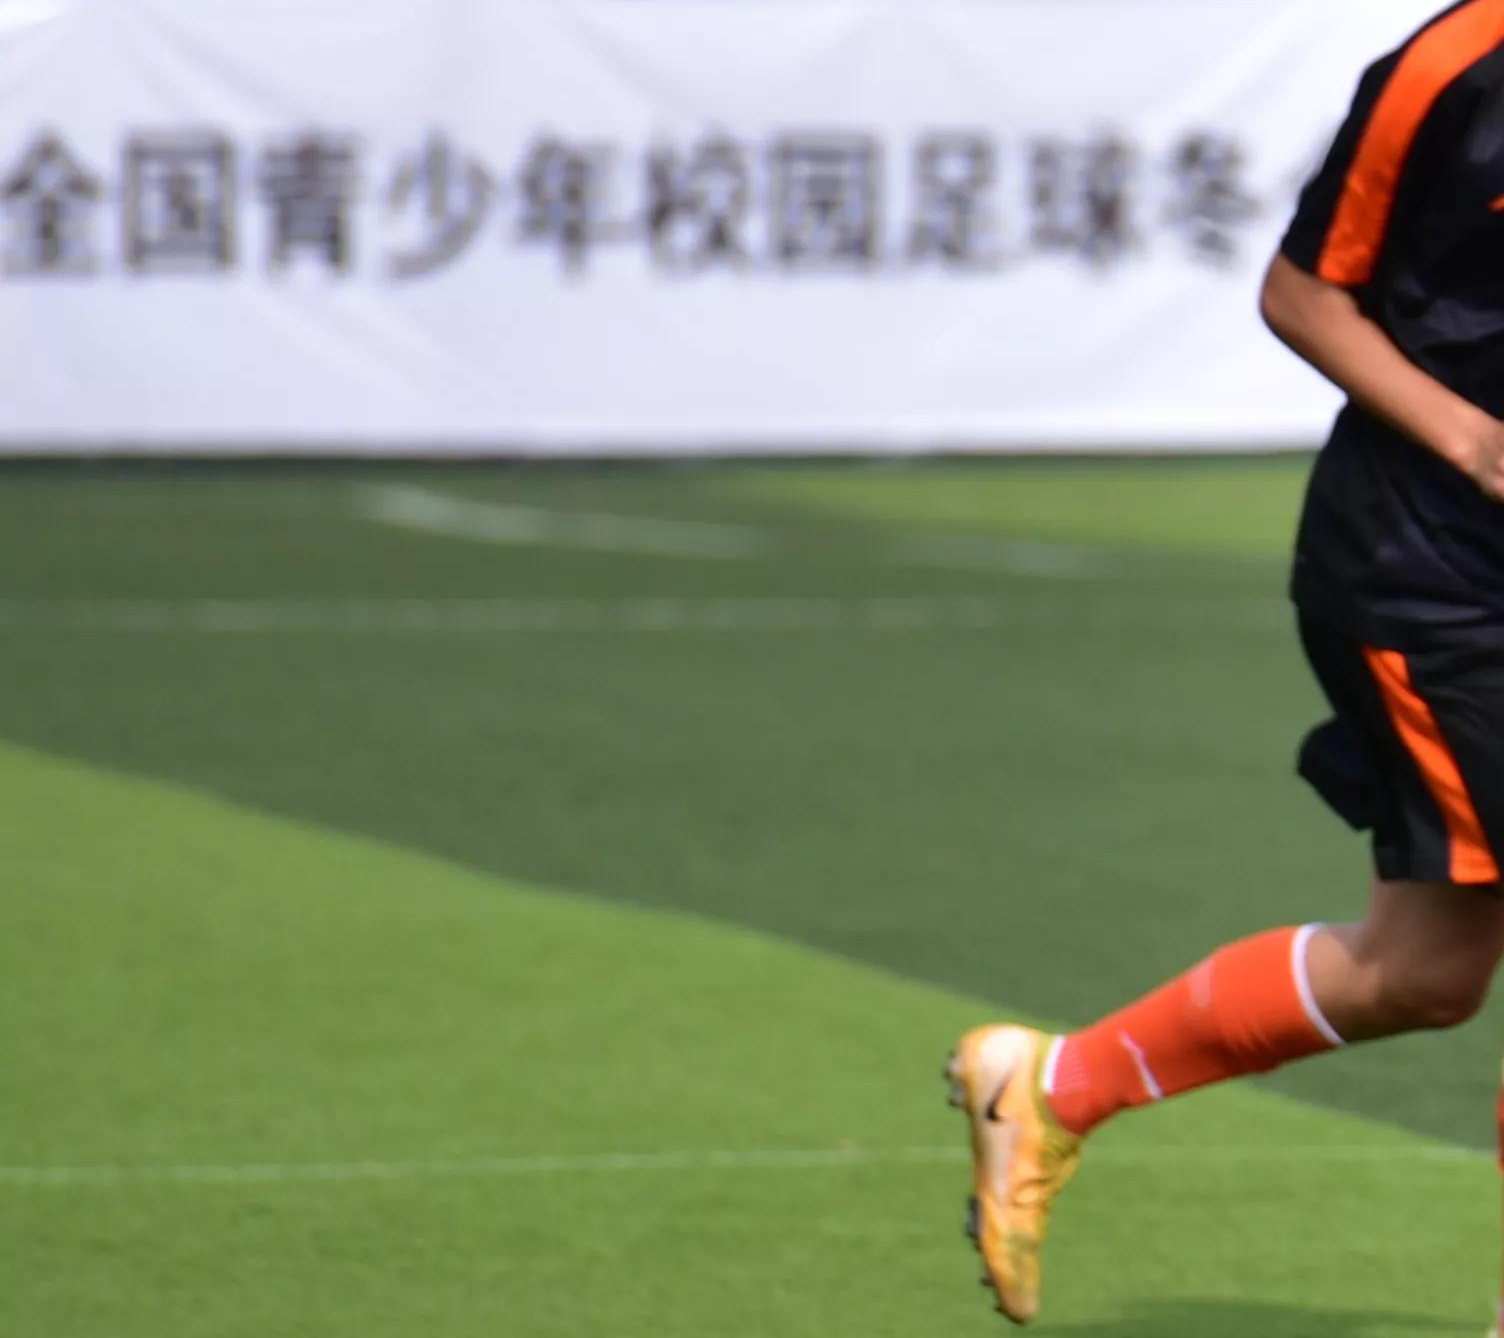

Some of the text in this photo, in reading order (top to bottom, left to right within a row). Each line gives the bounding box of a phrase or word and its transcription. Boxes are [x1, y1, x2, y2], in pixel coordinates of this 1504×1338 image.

[0, 125, 1264, 285] 全国青少年校园足球冬
